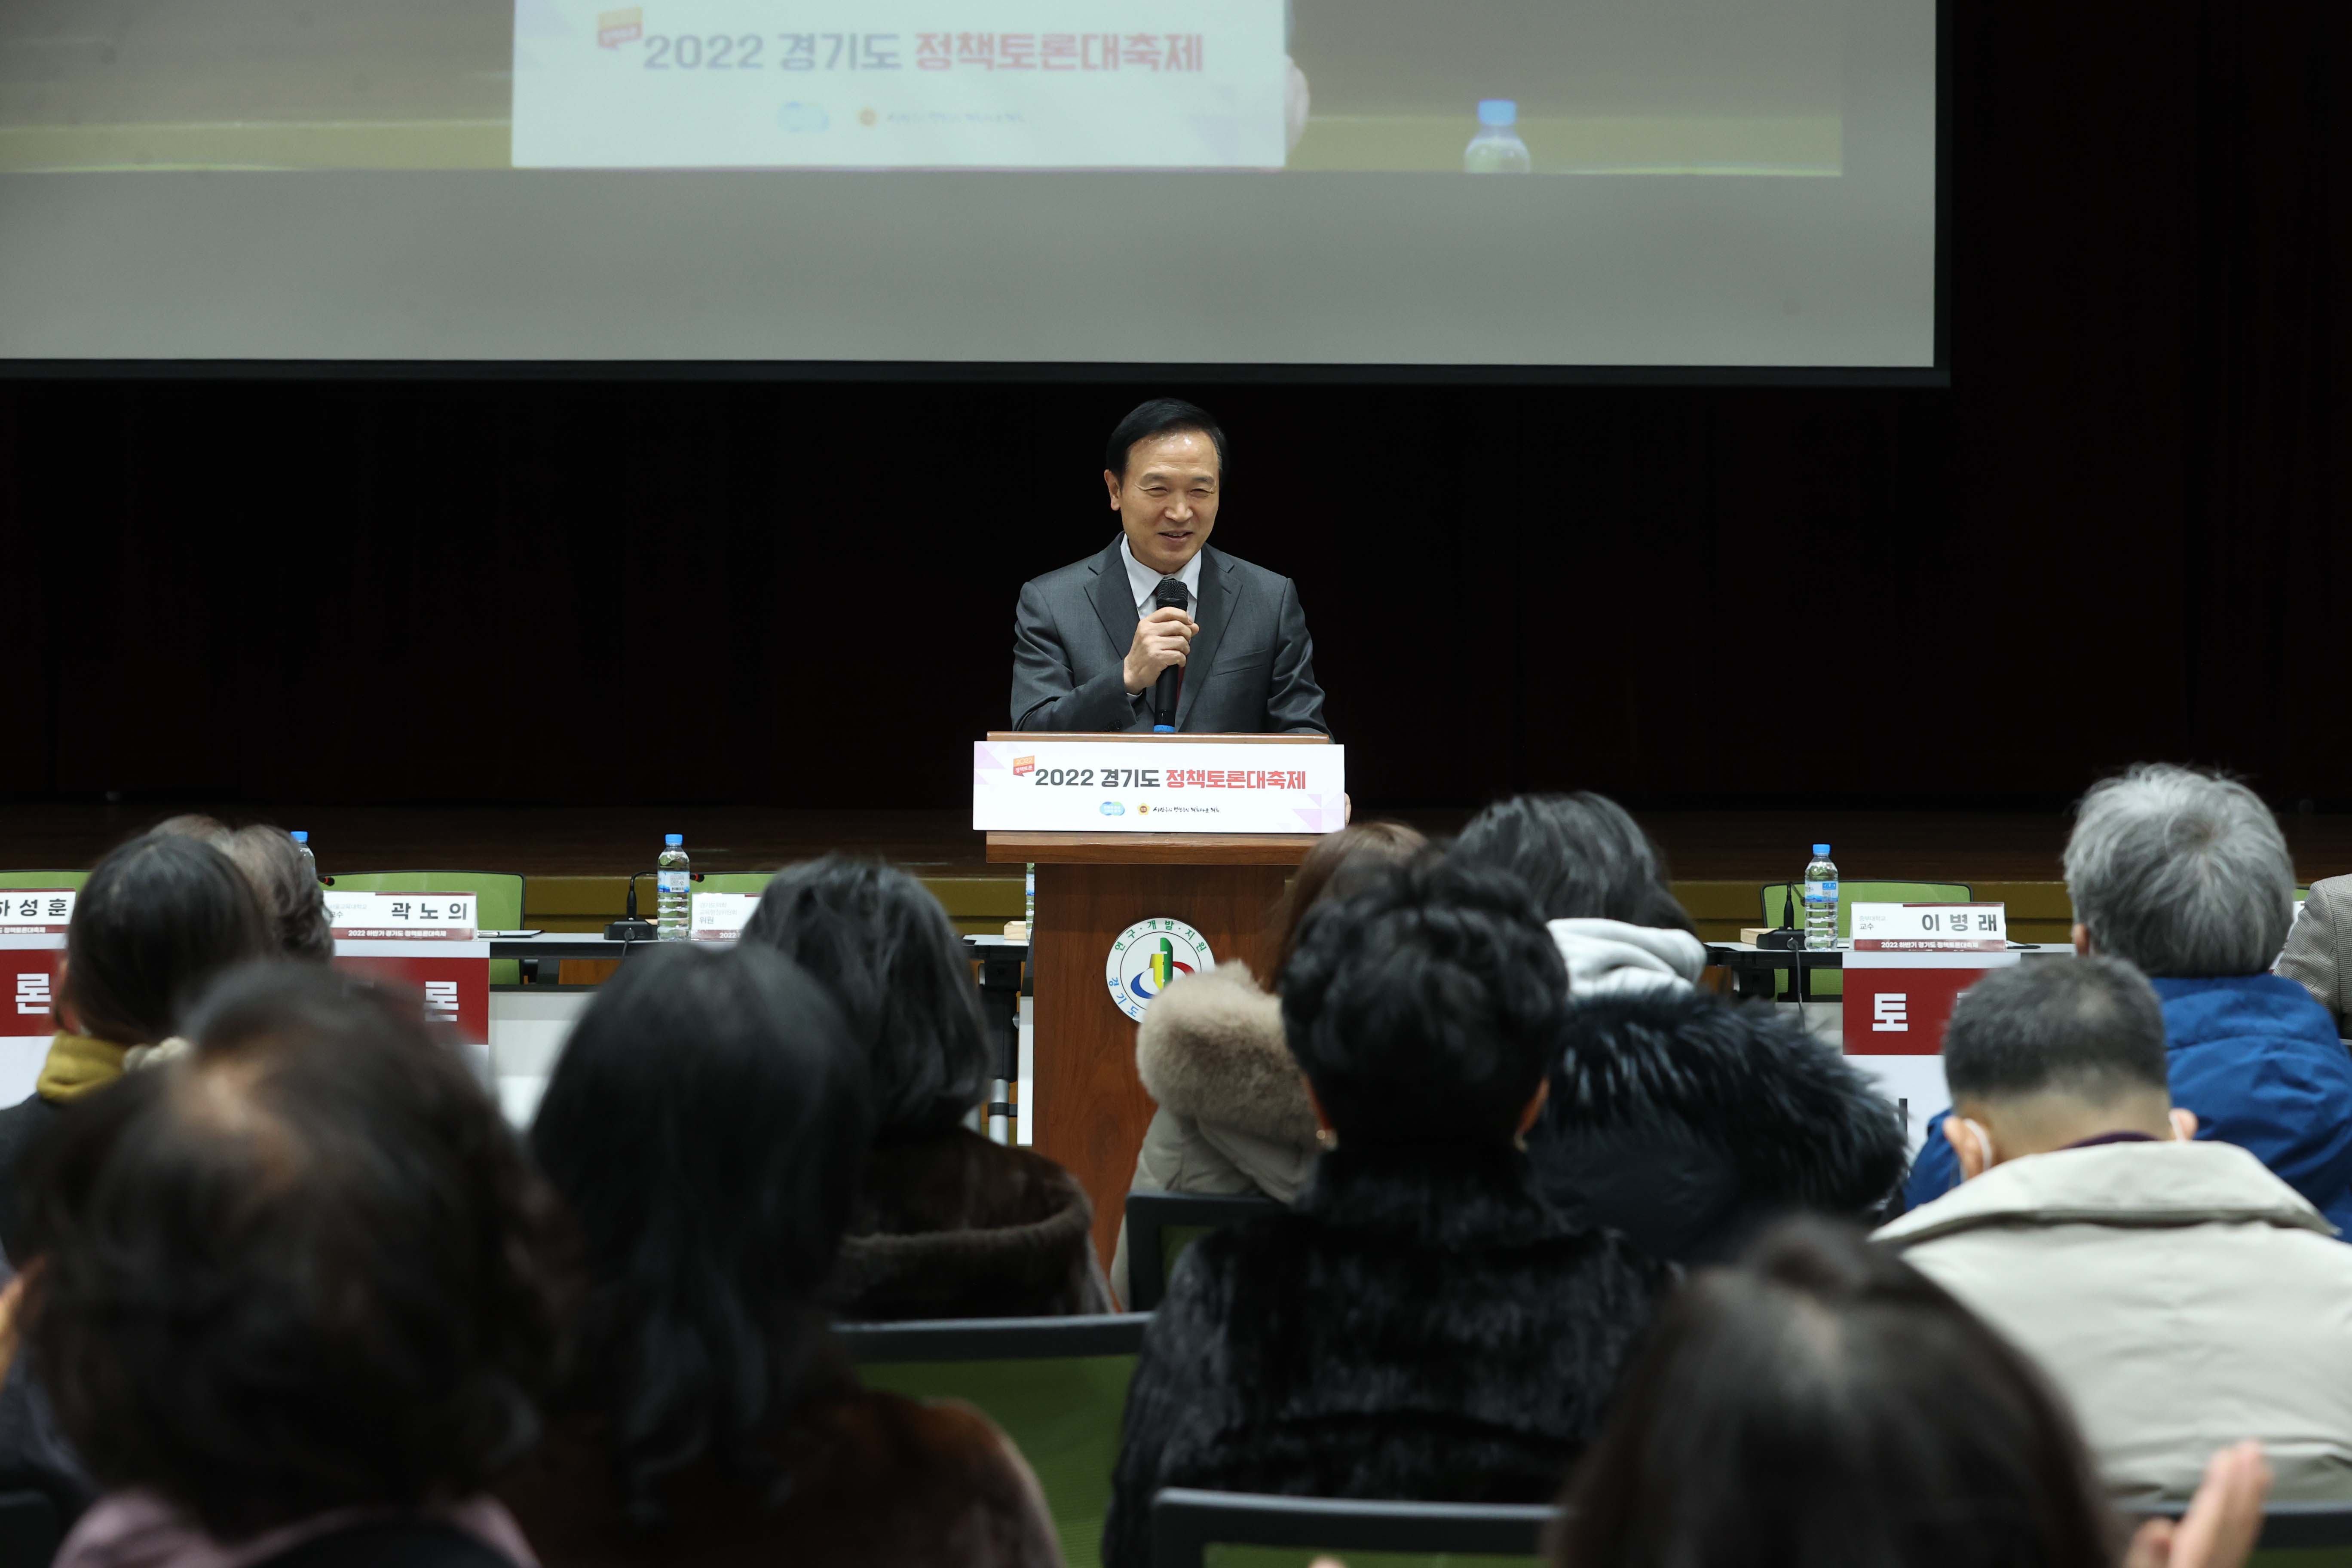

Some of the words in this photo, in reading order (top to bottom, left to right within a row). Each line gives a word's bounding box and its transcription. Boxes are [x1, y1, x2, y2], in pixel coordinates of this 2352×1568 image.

[644, 34, 764, 70] 2022
[778, 32, 902, 71] 경기도
[914, 32, 1204, 72] 정책토론대축제
[1035, 769, 1094, 786] 2022
[1100, 769, 1161, 787] 경기도
[1166, 769, 1306, 789] 정책토론대축제
[699, 916, 714, 924] 위원
